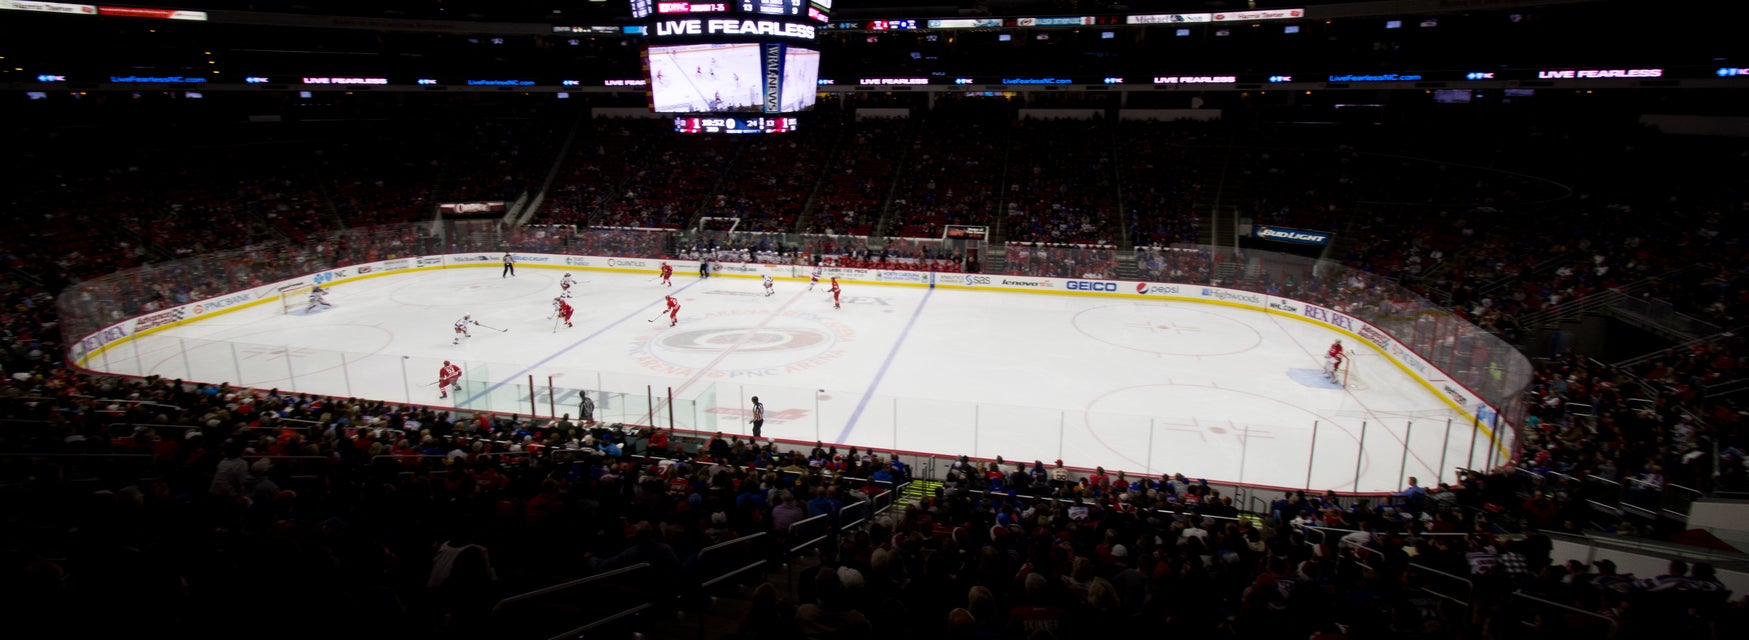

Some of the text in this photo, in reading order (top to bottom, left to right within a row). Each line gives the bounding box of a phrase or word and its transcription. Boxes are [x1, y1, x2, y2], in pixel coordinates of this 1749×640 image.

[657, 19, 816, 40] LIVE FEARLESS
[766, 45, 780, 111] WRAL NEWS
[1329, 74, 1422, 82] LiveFearlessNC.com
[1539, 69, 1663, 79] LIVE FEARLESS
[726, 118, 736, 129] 0
[1263, 228, 1327, 242] BUD LIGHT
[973, 276, 991, 285] sas
[1066, 281, 1116, 292] GEICO
[1150, 285, 1179, 295] pepsi
[1305, 304, 1354, 331] REX REX
